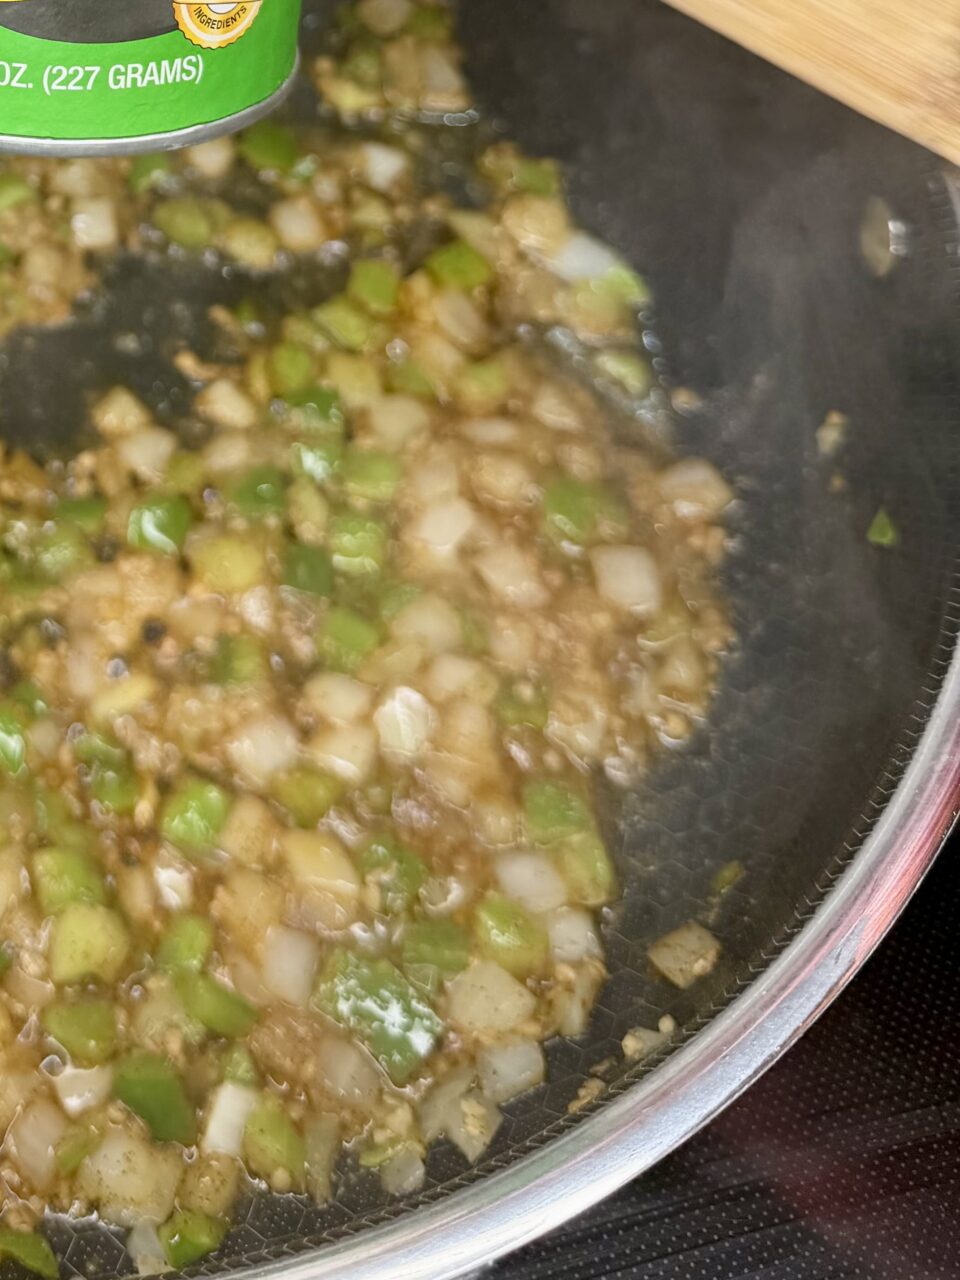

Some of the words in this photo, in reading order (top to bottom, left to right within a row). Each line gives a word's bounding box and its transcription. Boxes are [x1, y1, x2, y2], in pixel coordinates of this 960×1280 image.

[193, 5, 248, 30] INGREDIENTS
[42, 65, 101, 96] (227
[107, 54, 205, 90] GRAMS)
